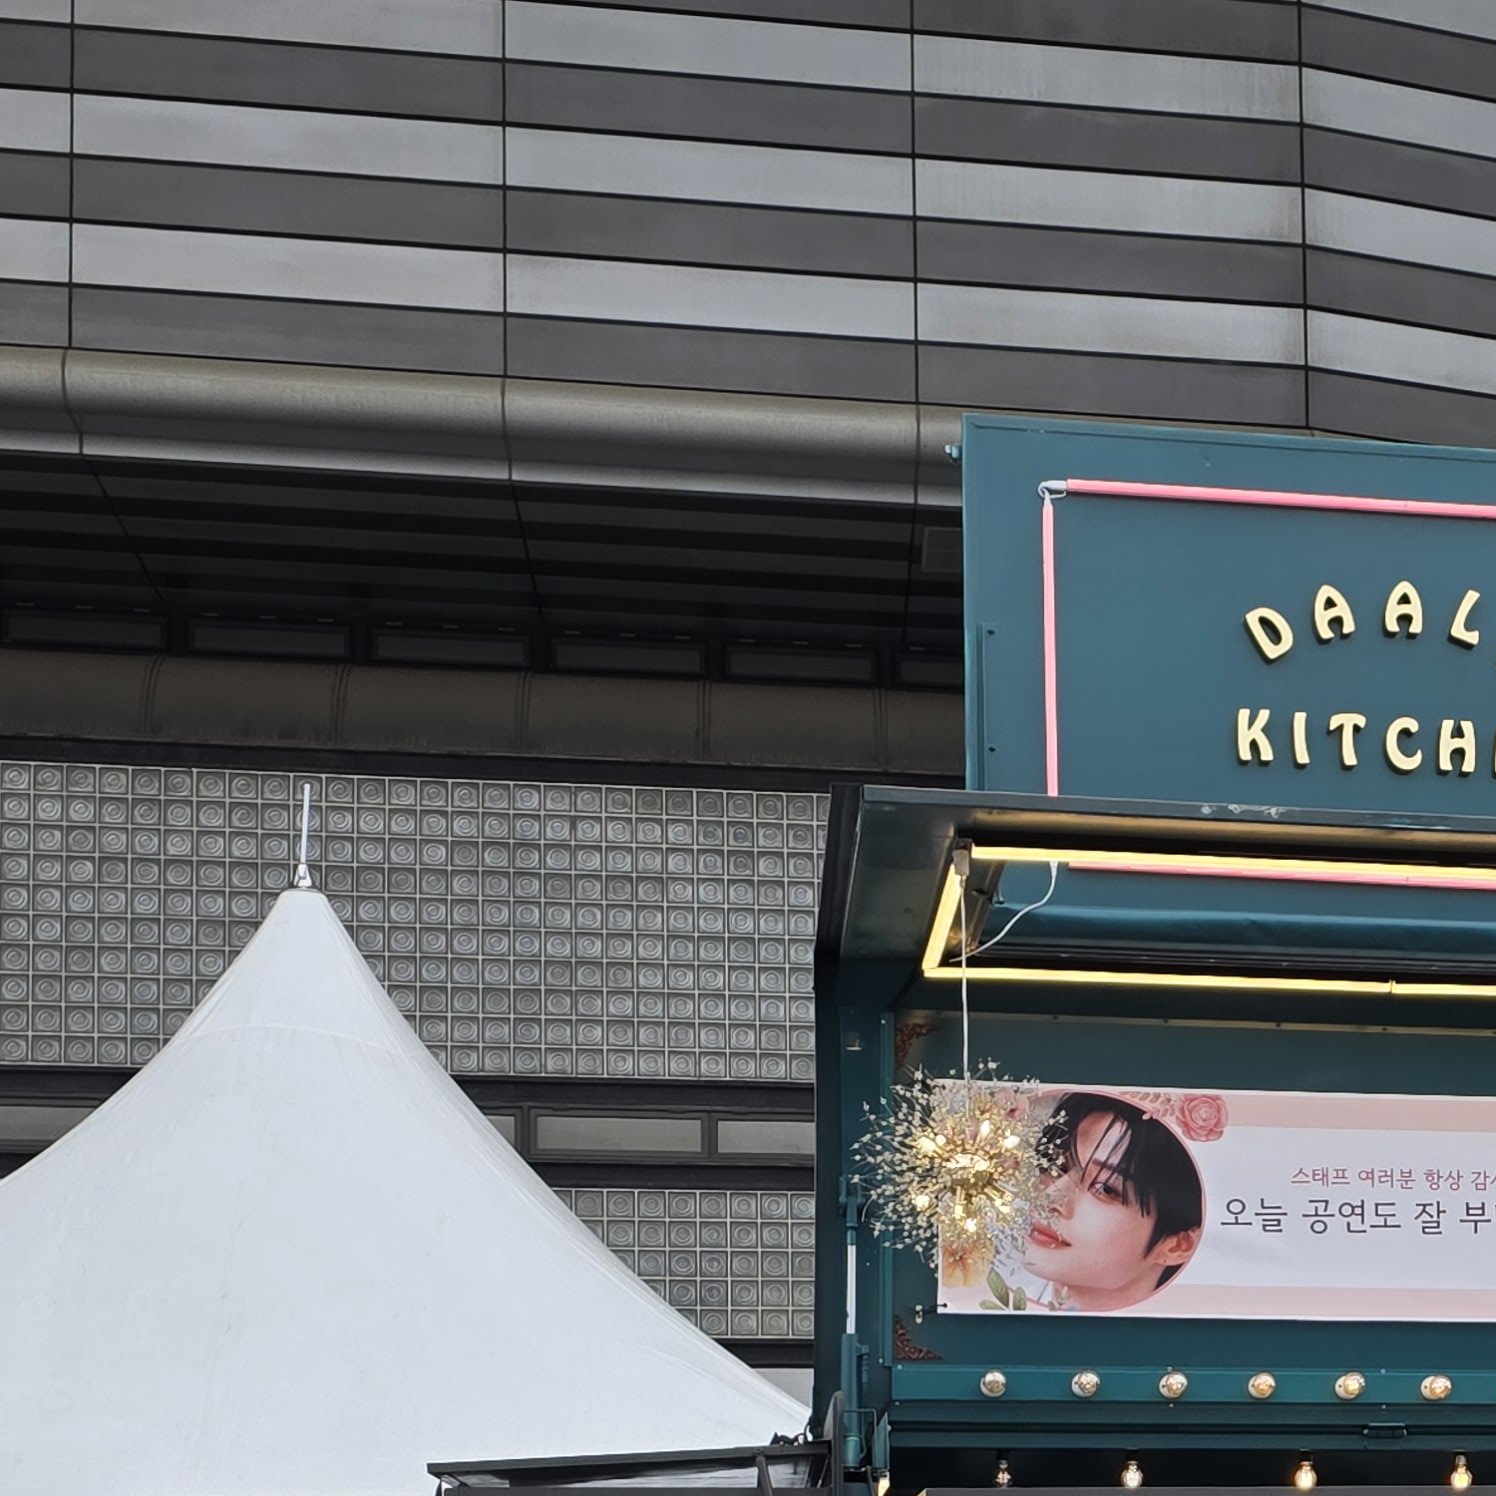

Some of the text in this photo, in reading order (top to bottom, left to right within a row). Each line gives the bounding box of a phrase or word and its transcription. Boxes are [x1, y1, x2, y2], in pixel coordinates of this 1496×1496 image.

[1290, 1166, 1351, 1188] 스태프
[1357, 1167, 1417, 1190] 여러분
[1423, 1168, 1465, 1192] 항상
[1219, 1197, 1289, 1235] 오늘
[1301, 1198, 1402, 1235] 공연도
[1413, 1200, 1448, 1237] 잘
